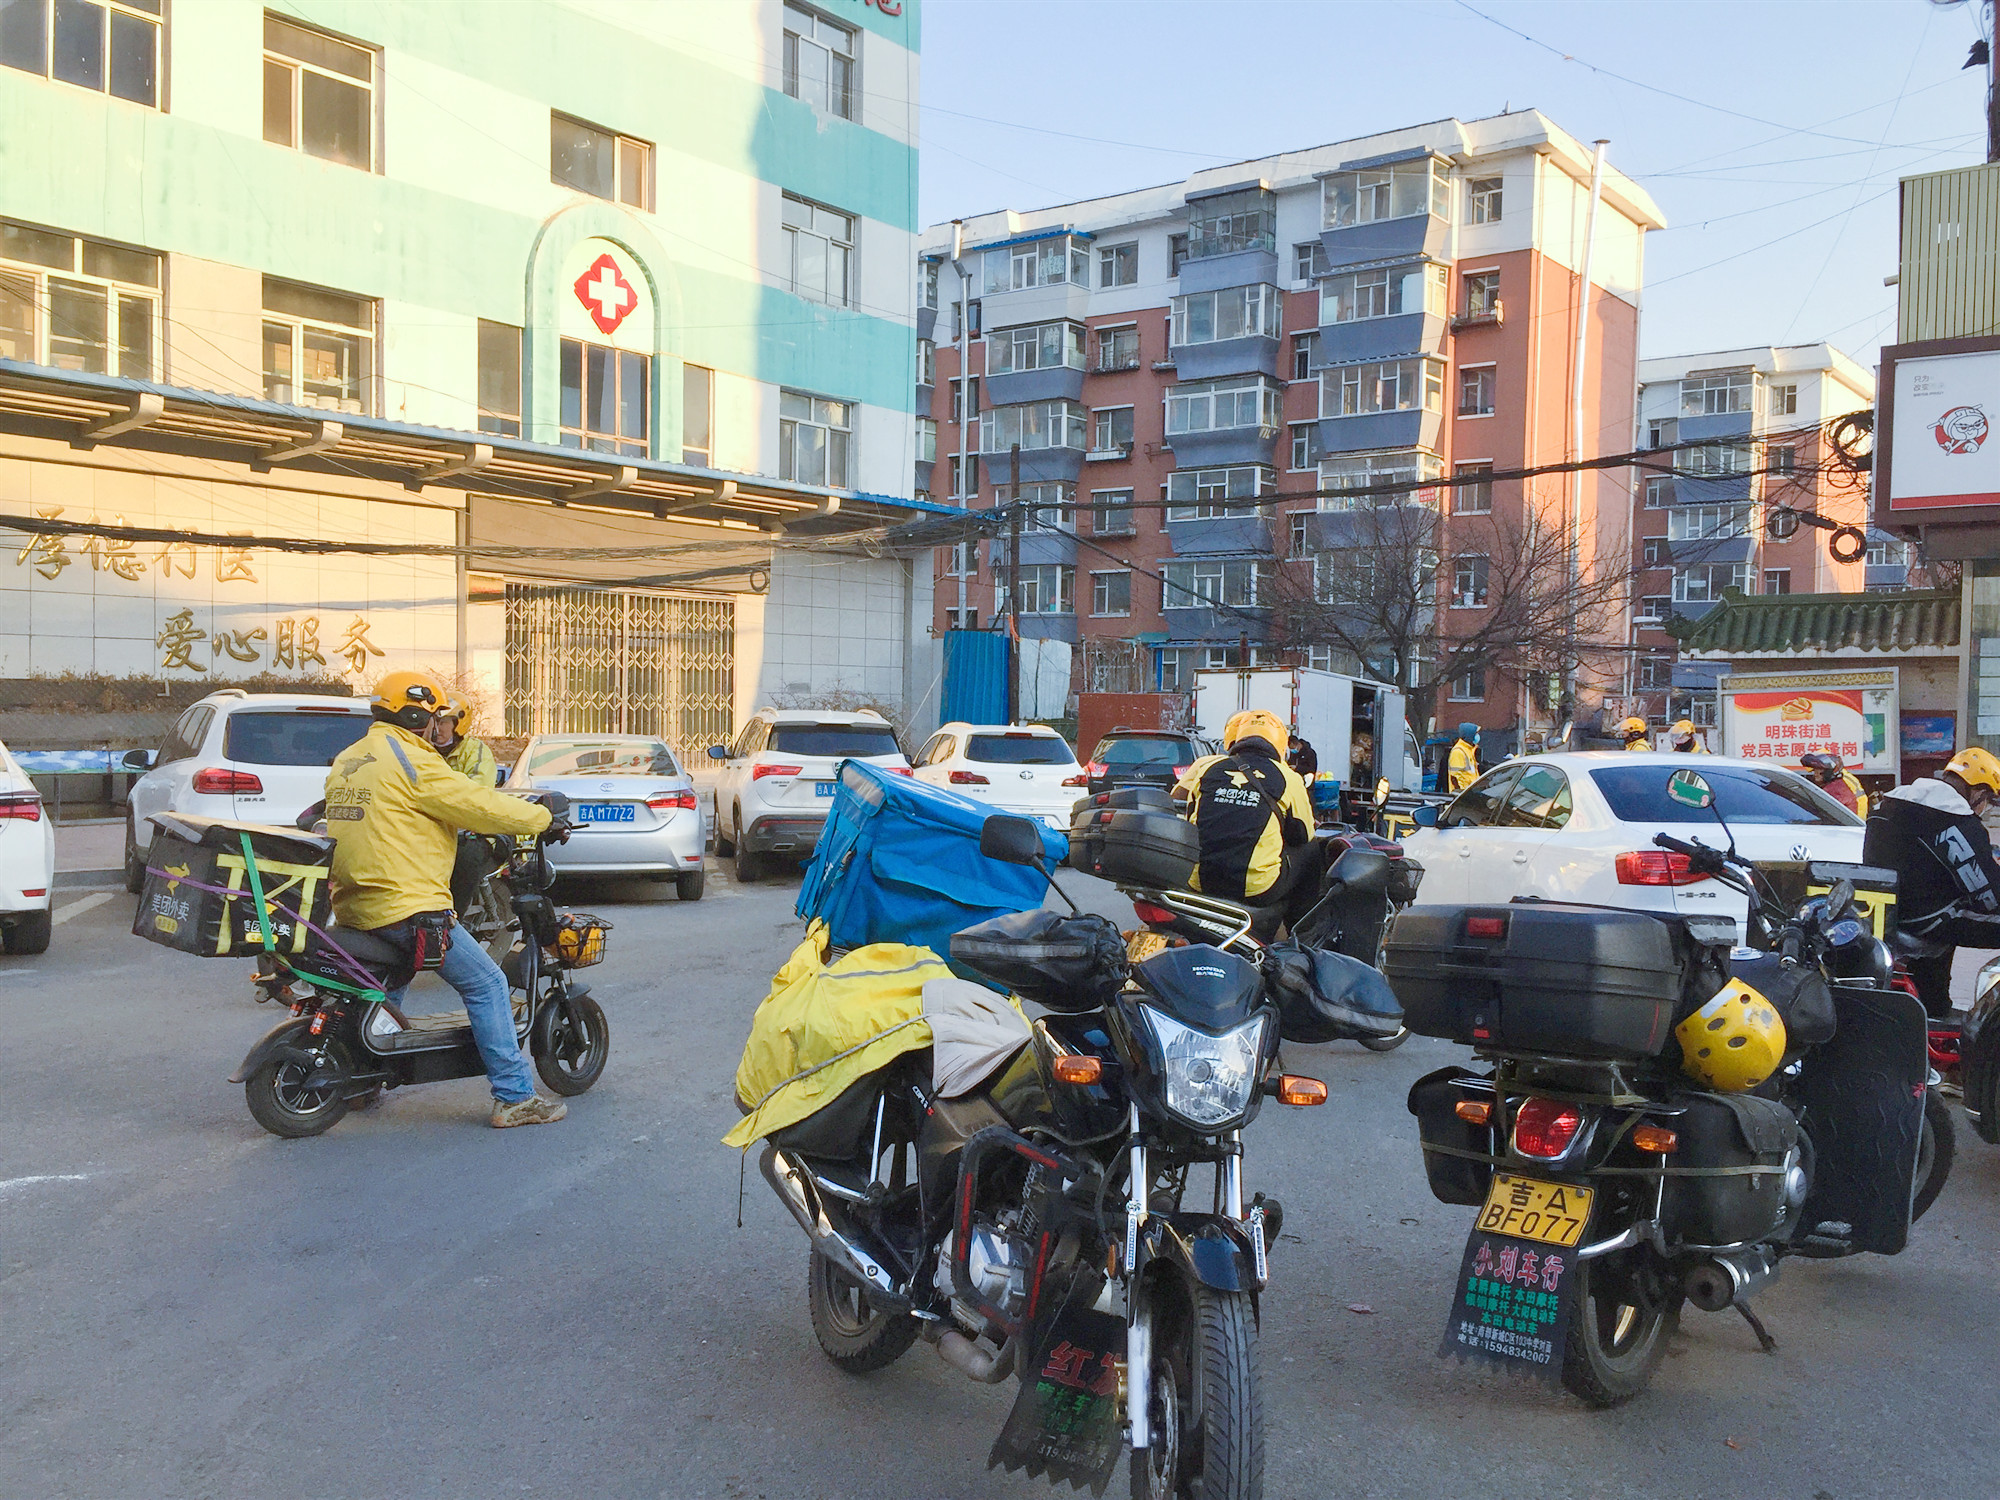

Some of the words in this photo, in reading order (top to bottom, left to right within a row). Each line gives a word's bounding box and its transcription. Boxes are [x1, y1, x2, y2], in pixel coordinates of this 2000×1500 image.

[155, 607, 386, 674] 爱心服务
[1765, 723, 1831, 739] 明珠街道
[1215, 787, 1261, 803] 美团外卖
[150, 893, 190, 922] 美团外卖
[1192, 966, 1226, 975] HONDA
[1483, 1203, 1580, 1241] BF077
[1472, 1240, 1565, 1292] 小刘车行
[1514, 1288, 1559, 1311] 本田摩托
[1480, 1311, 1538, 1336] 本田电动车
